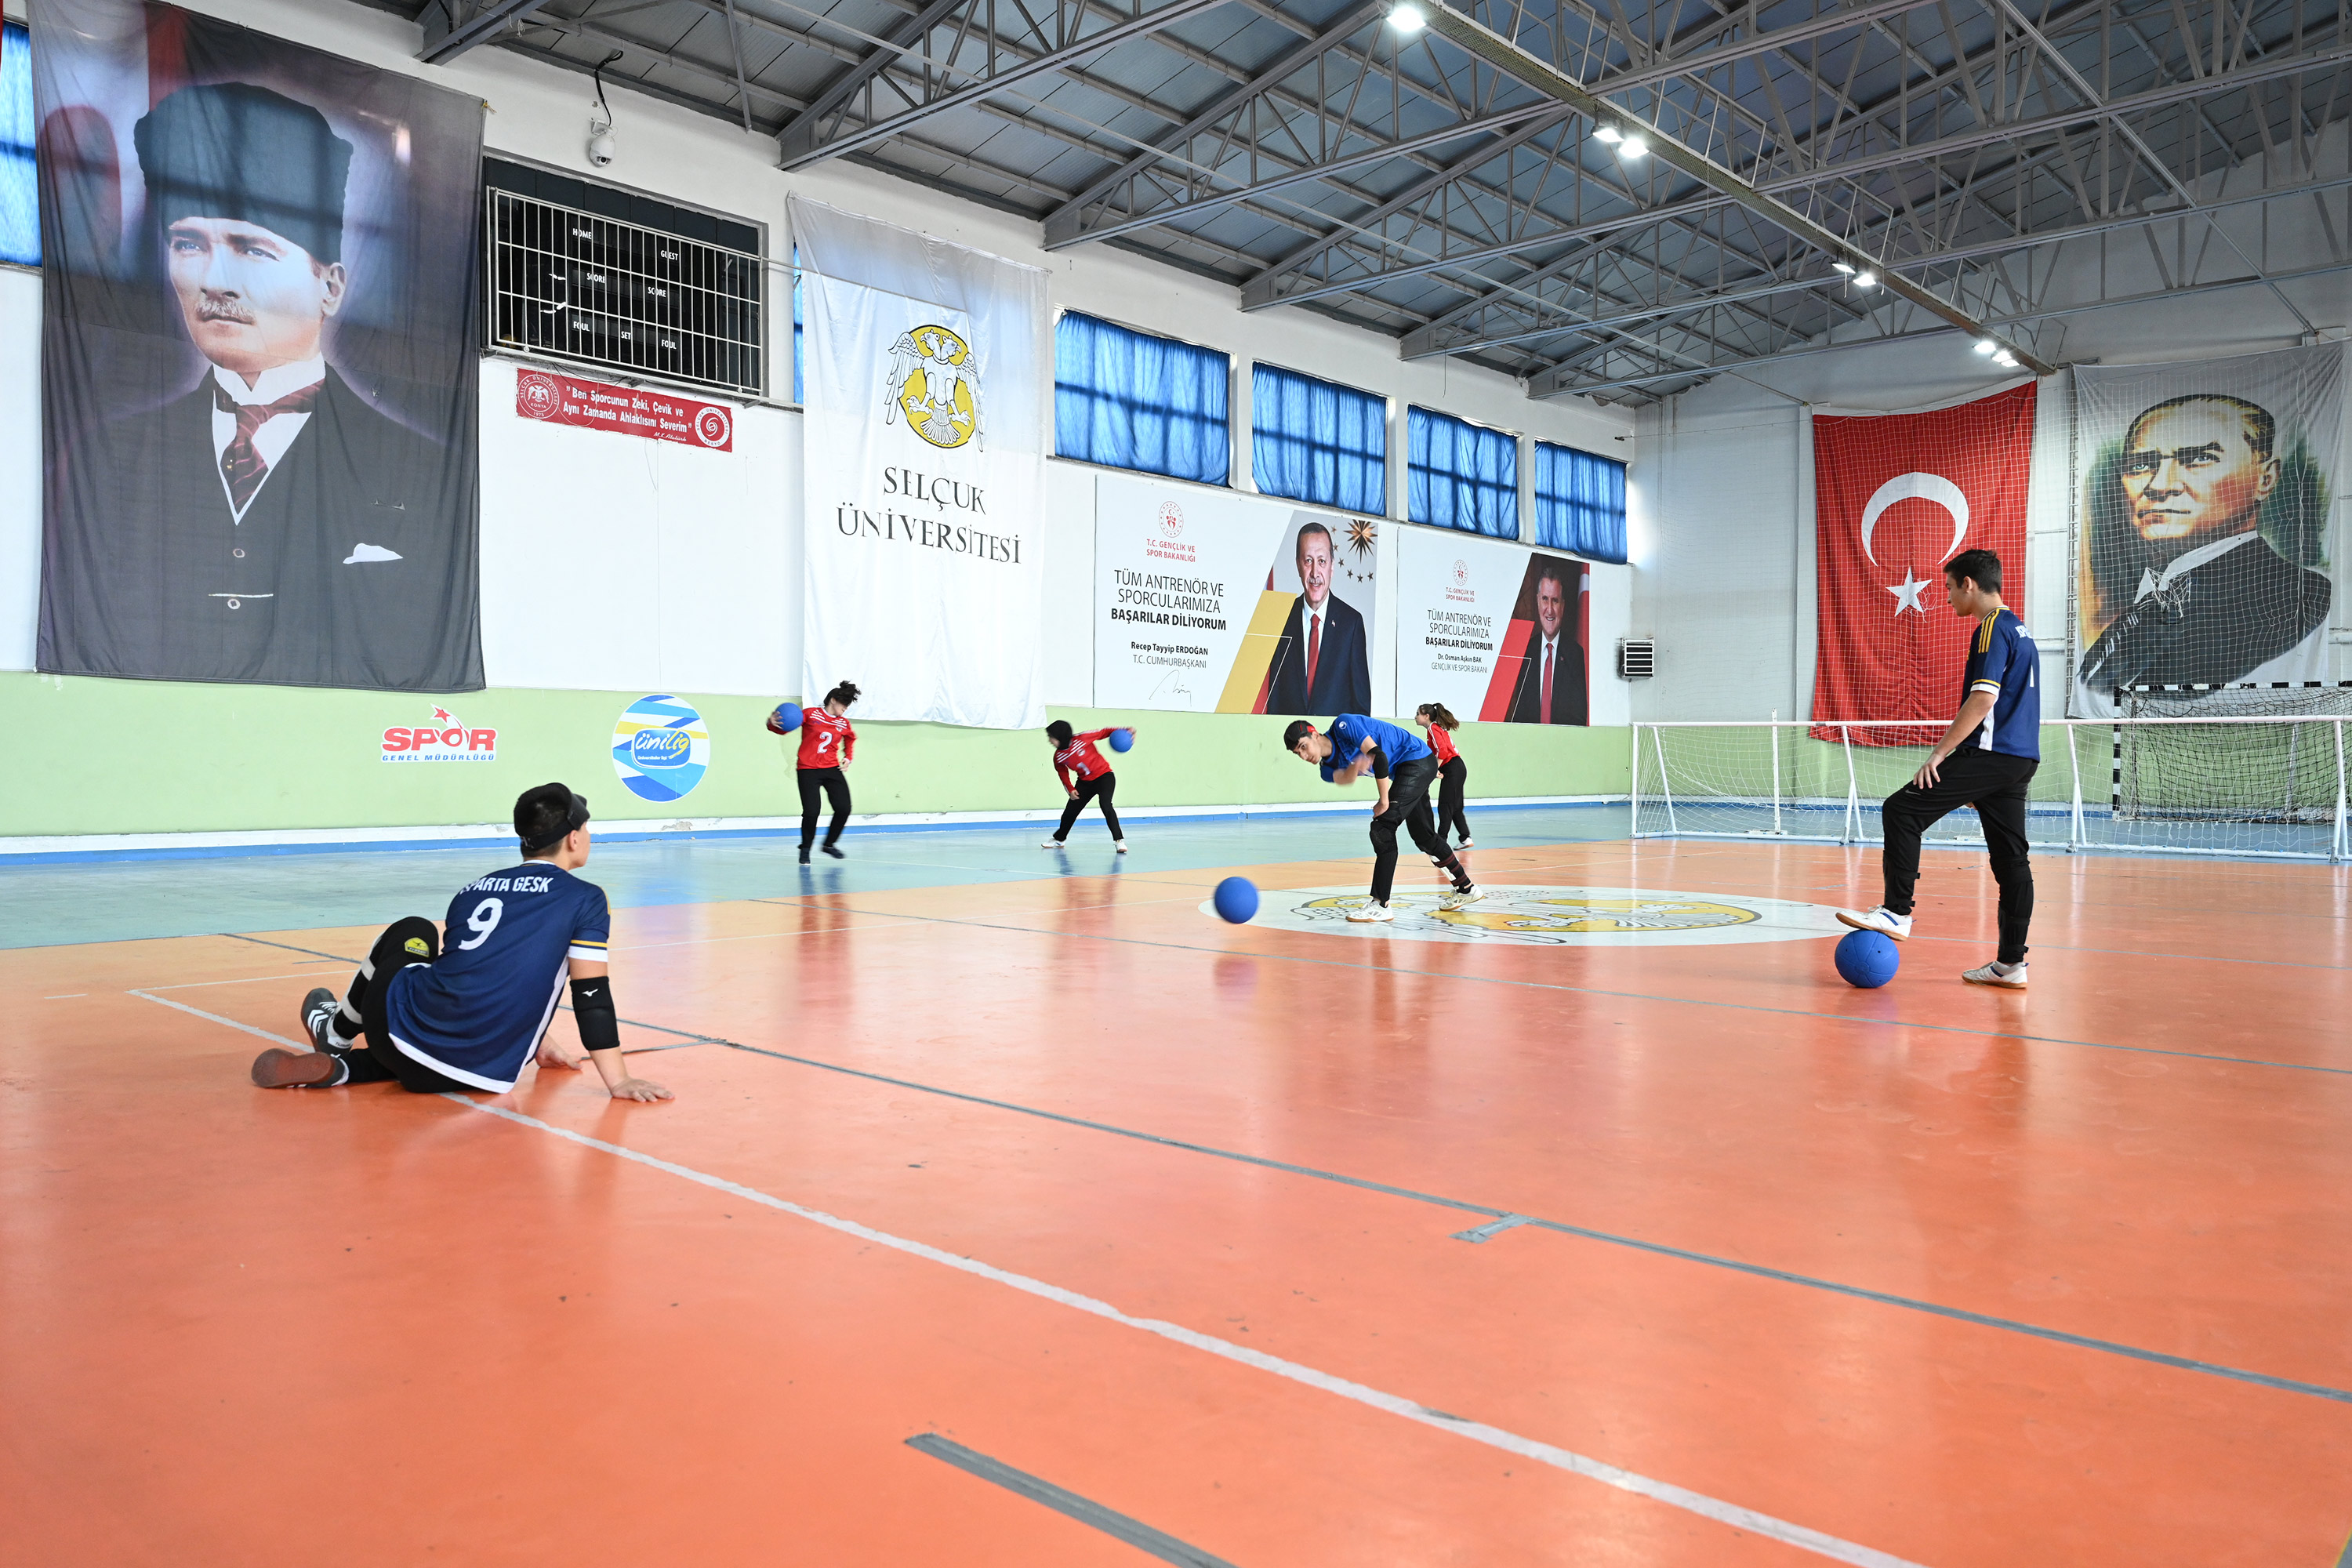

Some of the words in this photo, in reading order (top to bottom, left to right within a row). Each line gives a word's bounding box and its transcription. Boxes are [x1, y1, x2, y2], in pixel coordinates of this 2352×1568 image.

[572, 227, 592, 239] HOME
[660, 249, 679, 261] GUEST
[648, 286, 666, 297] SCORE
[573, 321, 590, 331] FOUL
[621, 331, 631, 340] SET
[661, 339, 677, 349] FOUL
[590, 390, 629, 407] Sporcunun
[632, 397, 650, 412] Zeki,
[653, 401, 672, 415] Çevik
[675, 408, 684, 416] ve
[563, 401, 579, 416] Aynı
[583, 405, 616, 420] Zamanda
[619, 411, 657, 427] Ahlaklısını
[884, 466, 986, 515] SELÇUK
[836, 502, 1022, 564] ÜNİVERSİTESİ
[1146, 539, 1158, 547] T.C.
[1159, 541, 1186, 552] GENÇLİK
[1146, 549, 1163, 557] SPOR
[1163, 551, 1196, 562] BAKANLIĞI
[1114, 568, 1142, 586] TÜM
[1145, 574, 1208, 595] ANTRENÖR
[1210, 583, 1224, 597] VE
[1118, 588, 1221, 613] SPORCULARIMIZA
[1111, 608, 1170, 625] BAŞARILAR
[1172, 613, 1226, 630] DİLİYORUM
[1428, 608, 1443, 621] TÜM
[1445, 612, 1482, 626] ANTRENÖR
[1483, 616, 1491, 627] VE
[1429, 622, 1490, 638] SPORCULARIMIZA
[1131, 641, 1152, 652] Recep
[1152, 644, 1174, 654] Tayyip
[1175, 645, 1208, 655] ERDOĞAN
[1425, 637, 1460, 648] BAŞARILAR
[1461, 639, 1493, 651] DİLİYORUM
[1133, 655, 1145, 664] T.C.
[1146, 655, 1207, 669] CUMHURBAŞKANI
[382, 728, 496, 751] SPOR
[817, 731, 833, 753] 2
[512, 876, 554, 893] GESK
[458, 897, 504, 950] 9
